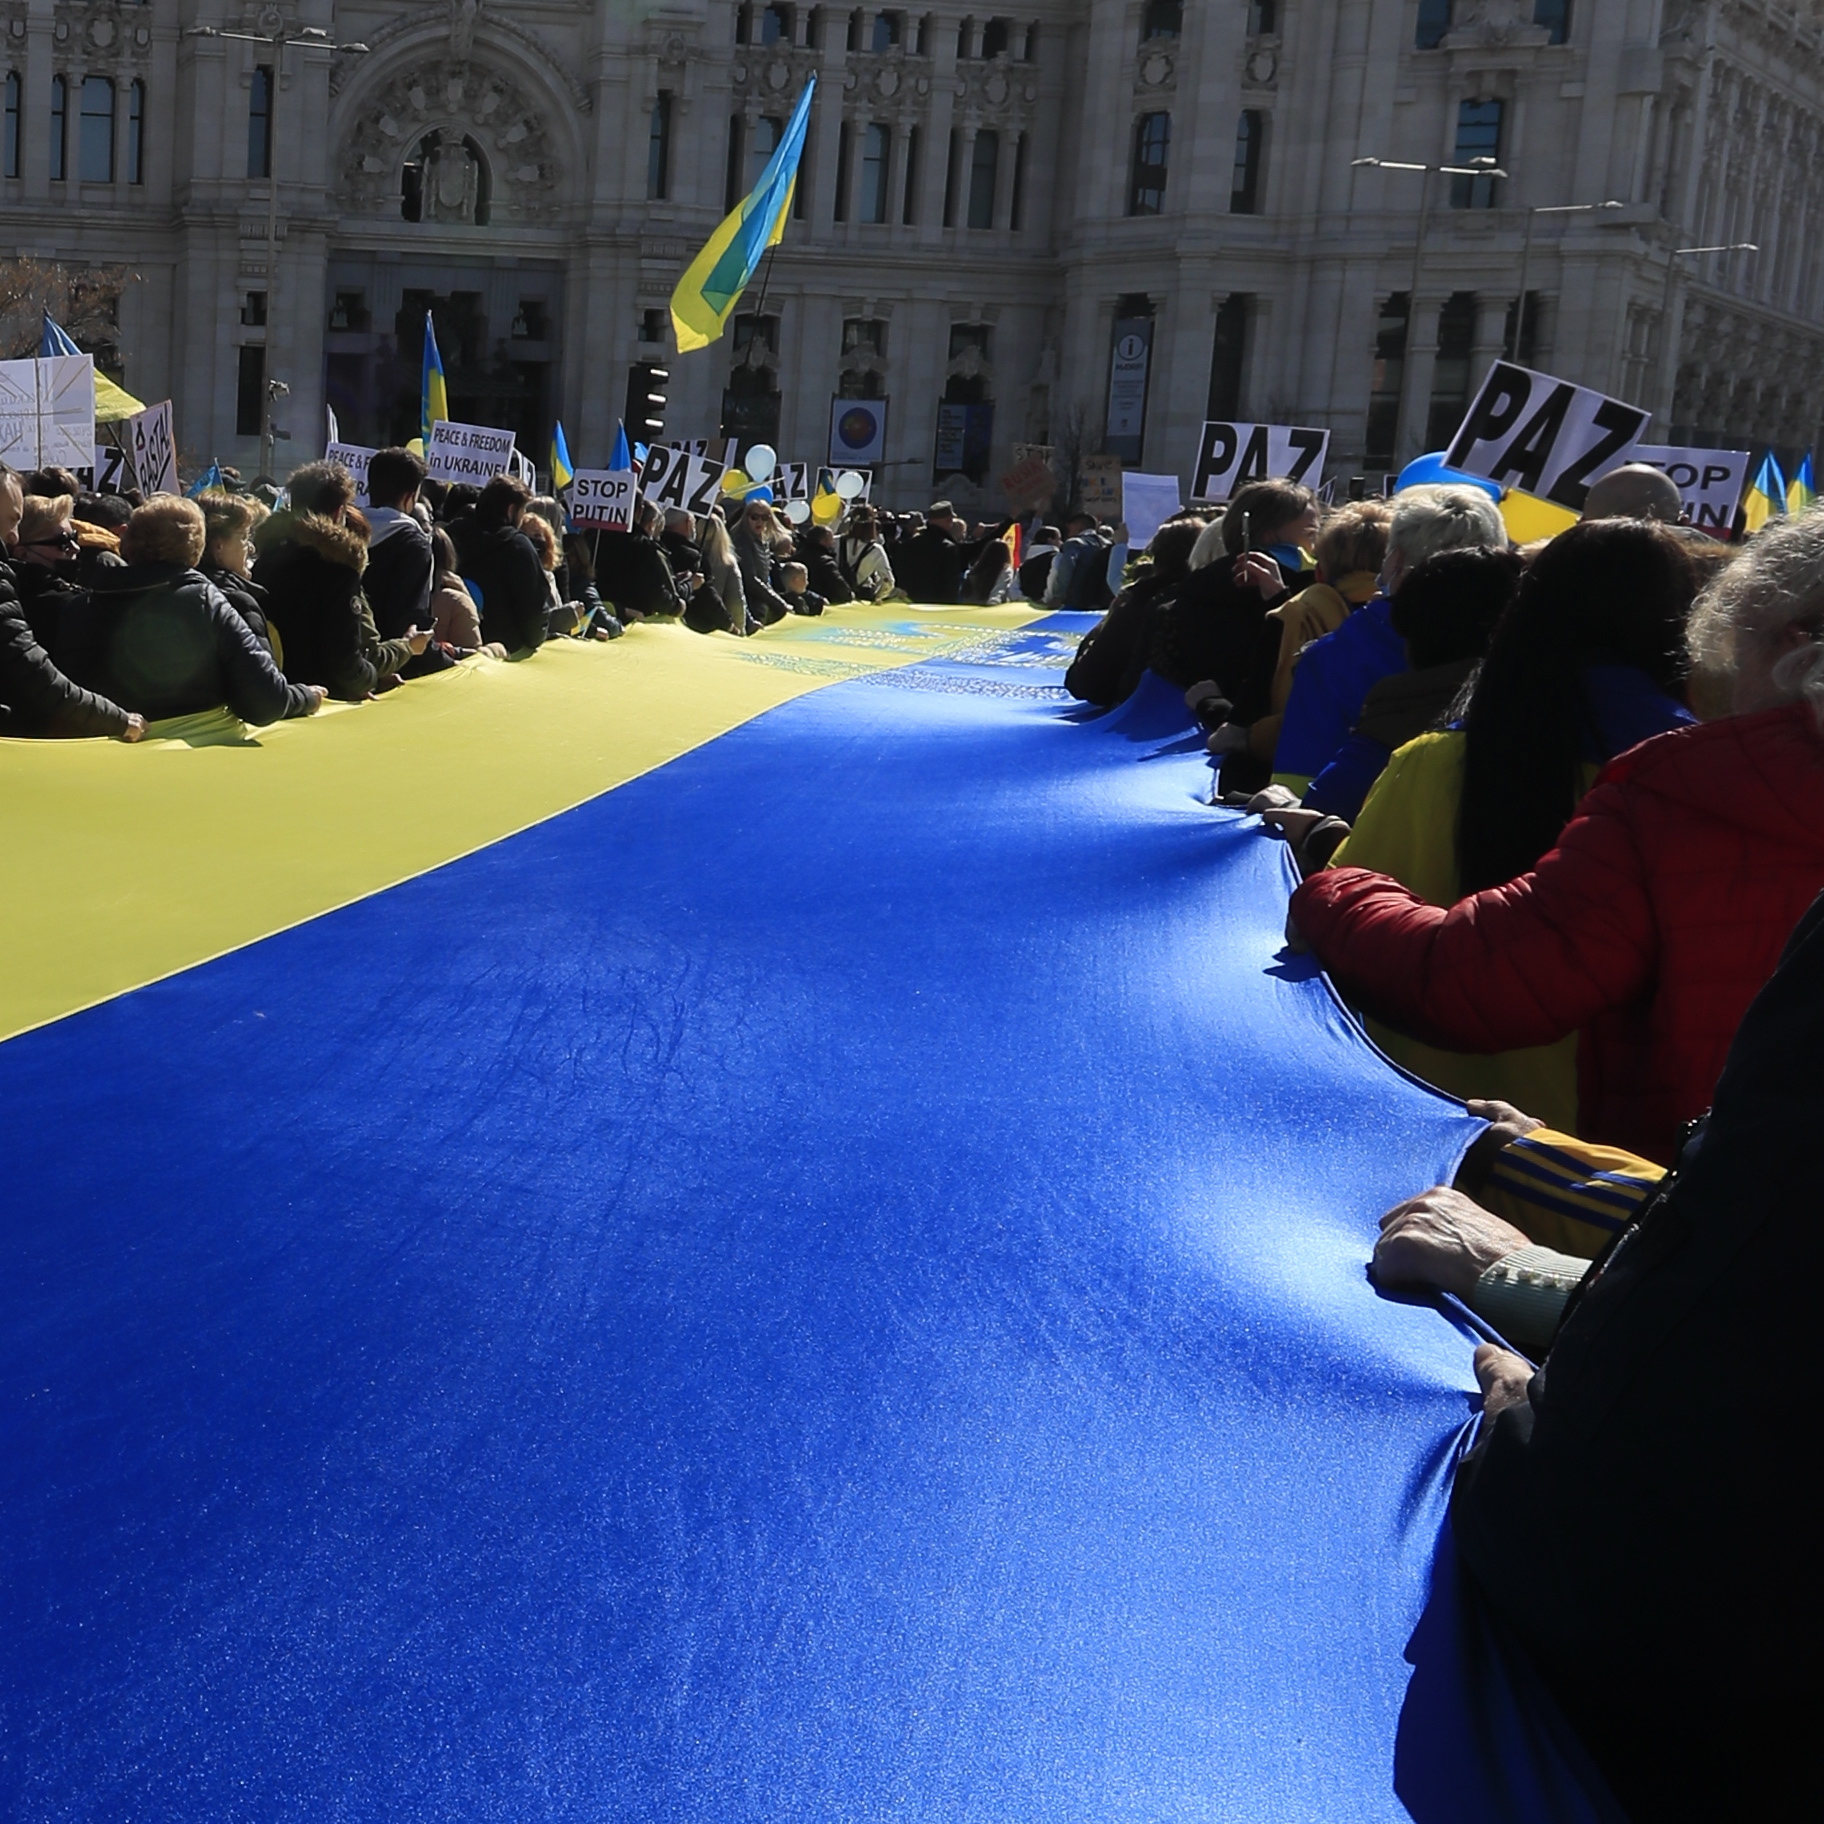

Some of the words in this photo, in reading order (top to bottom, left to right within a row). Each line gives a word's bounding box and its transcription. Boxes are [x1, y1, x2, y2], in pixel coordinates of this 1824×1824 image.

[433, 427, 461, 445] PEACE
[461, 432, 468, 444] &
[469, 433, 511, 454] FREEDOM
[1447, 368, 1646, 511] PAZ
[328, 449, 355, 468] PEACE
[355, 454, 363, 469] &
[429, 452, 441, 469] in
[444, 457, 507, 477] UKRAINE!
[1194, 423, 1323, 501] PAZ
[577, 479, 628, 499] STOP
[640, 446, 725, 519] PAZ
[574, 504, 628, 524] PUTIN
